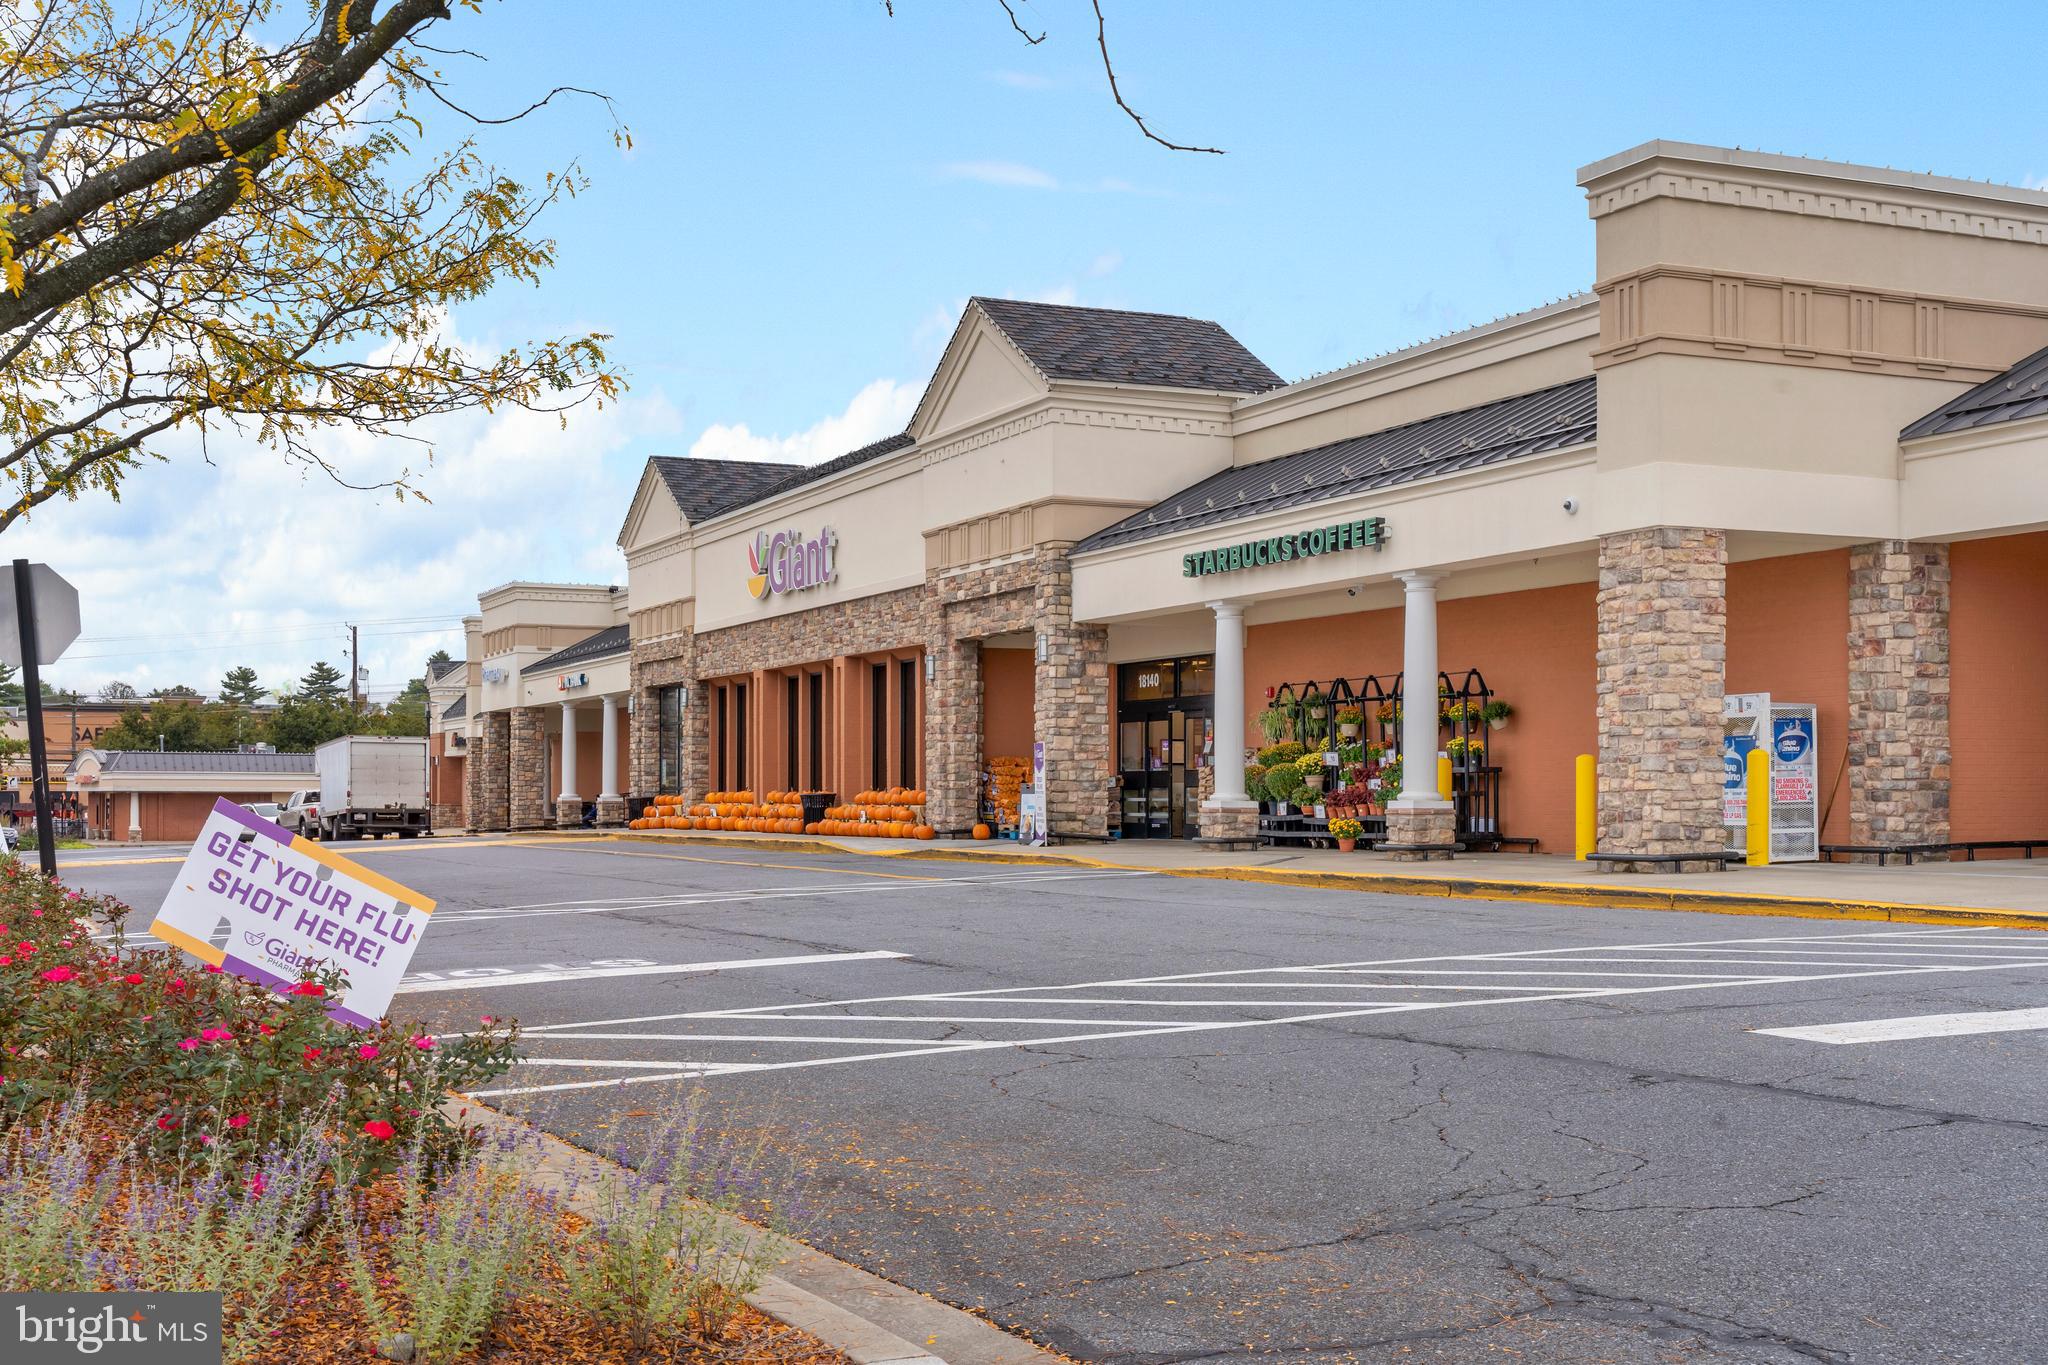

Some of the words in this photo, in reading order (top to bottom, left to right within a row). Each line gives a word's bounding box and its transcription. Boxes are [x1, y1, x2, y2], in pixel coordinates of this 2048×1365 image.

[768, 526, 833, 594] Giant
[1183, 534, 1295, 577] STARBUCKS
[1296, 517, 1380, 558] COFFEE
[1138, 673, 1159, 688] 18140
[74, 727, 112, 741] SAF
[207, 831, 270, 874] GET
[273, 861, 352, 916] YOUR
[356, 901, 414, 945] FLU
[208, 868, 293, 922] SHOT
[294, 908, 386, 968] HERE!
[267, 957, 301, 978] PHARMA
